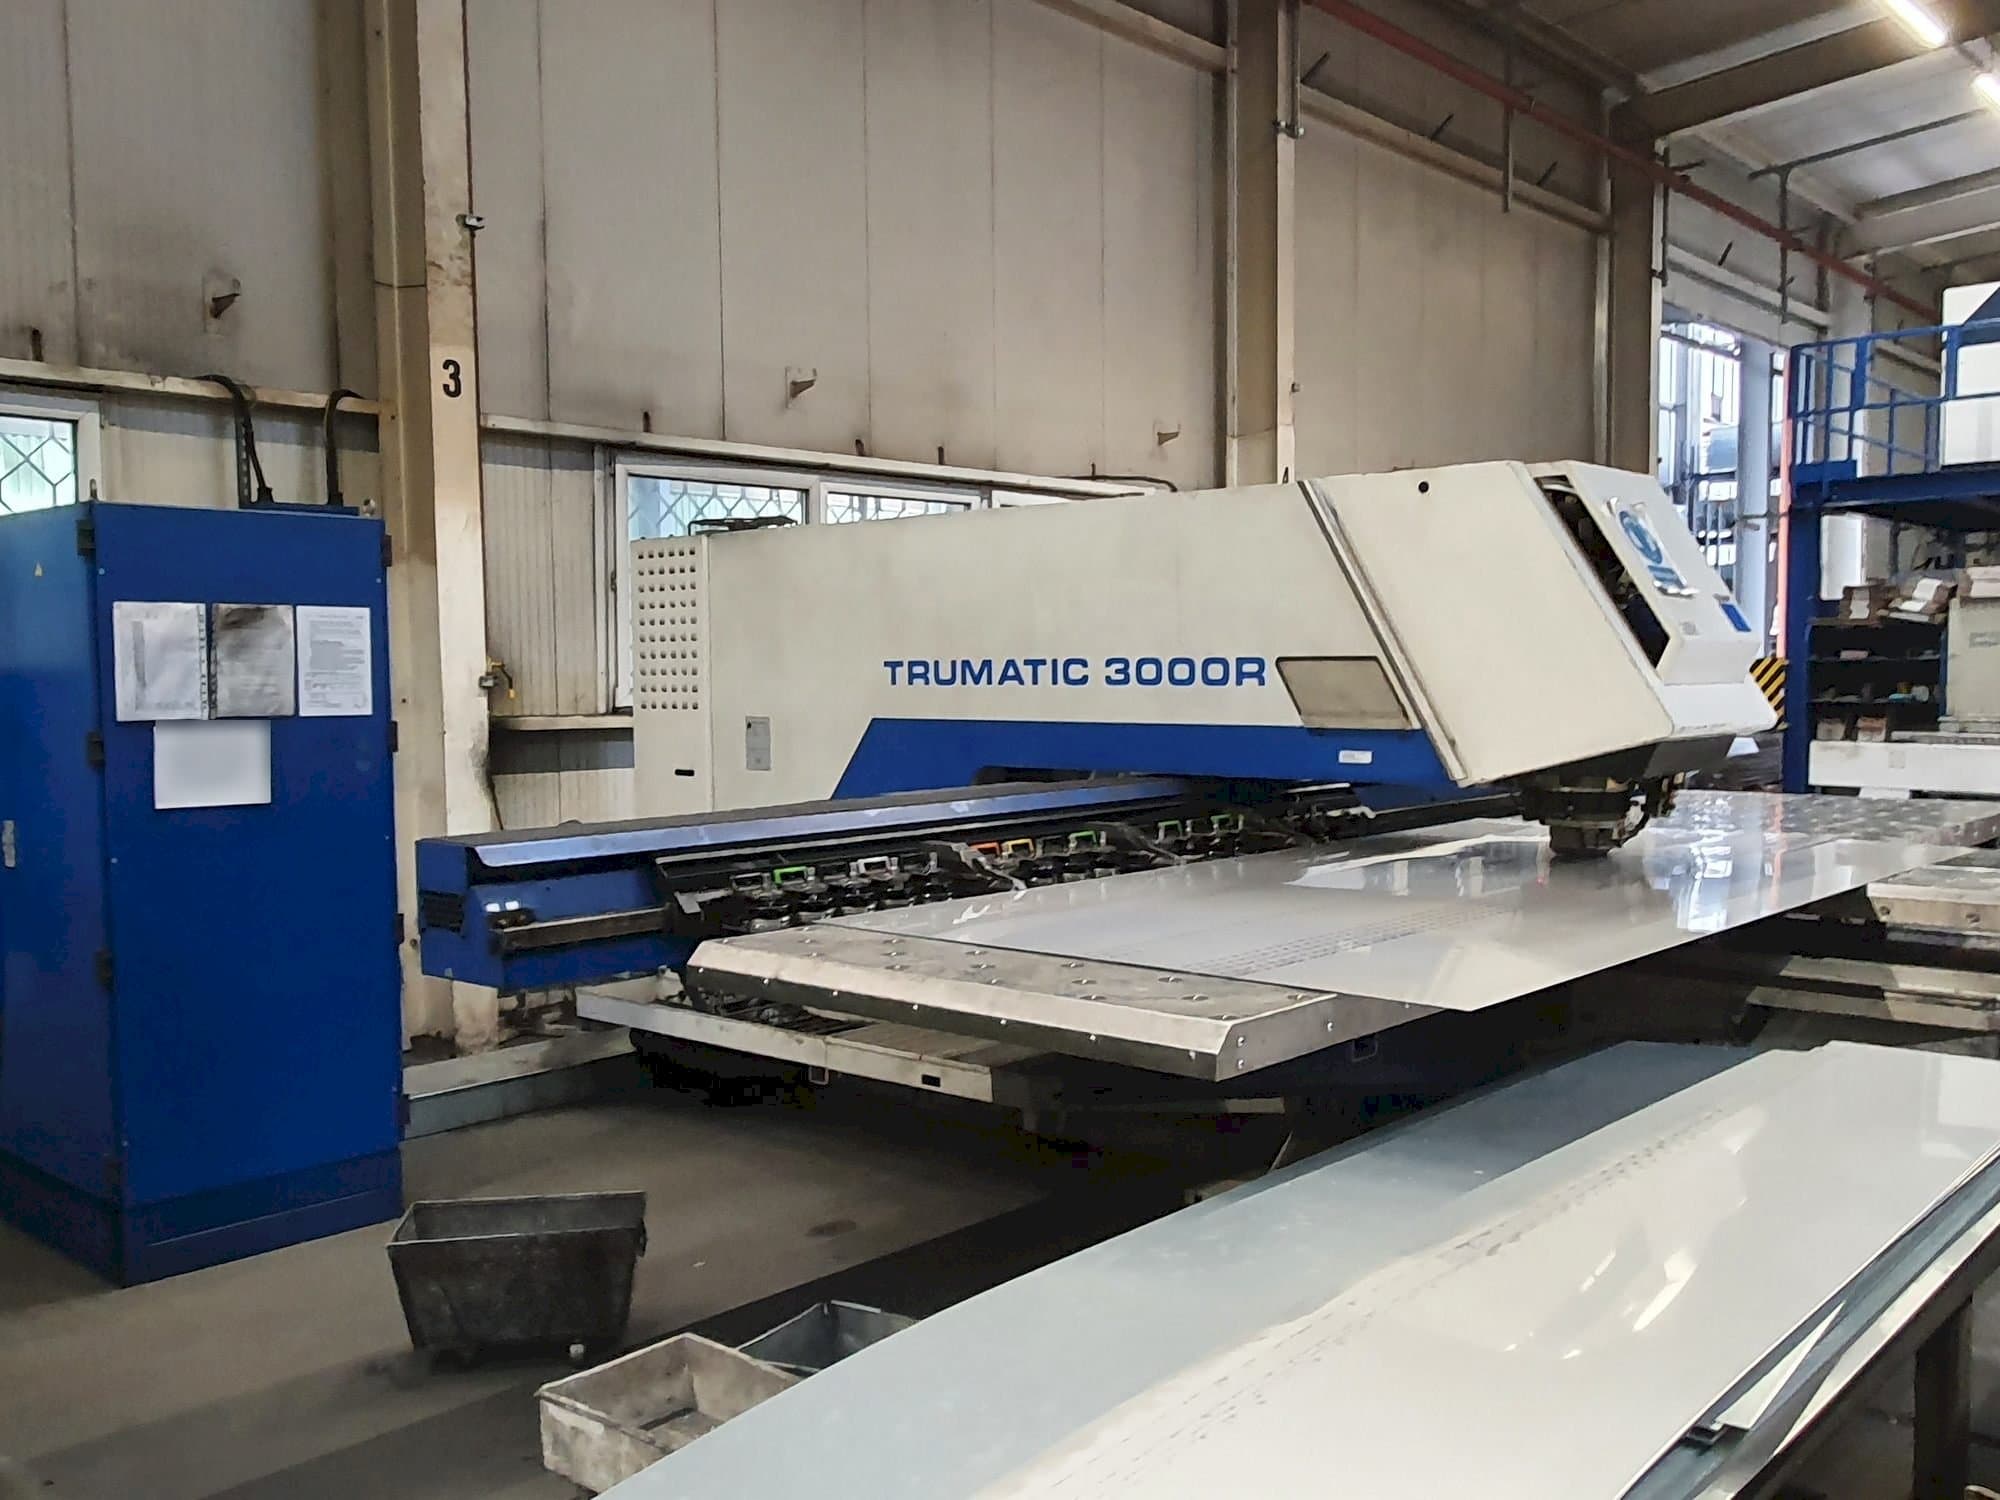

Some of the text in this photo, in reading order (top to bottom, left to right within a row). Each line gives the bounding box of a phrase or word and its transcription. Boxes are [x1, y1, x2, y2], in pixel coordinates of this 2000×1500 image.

[443, 359, 462, 398] 3
[883, 657, 1266, 687] TRUMATIC 3000R
